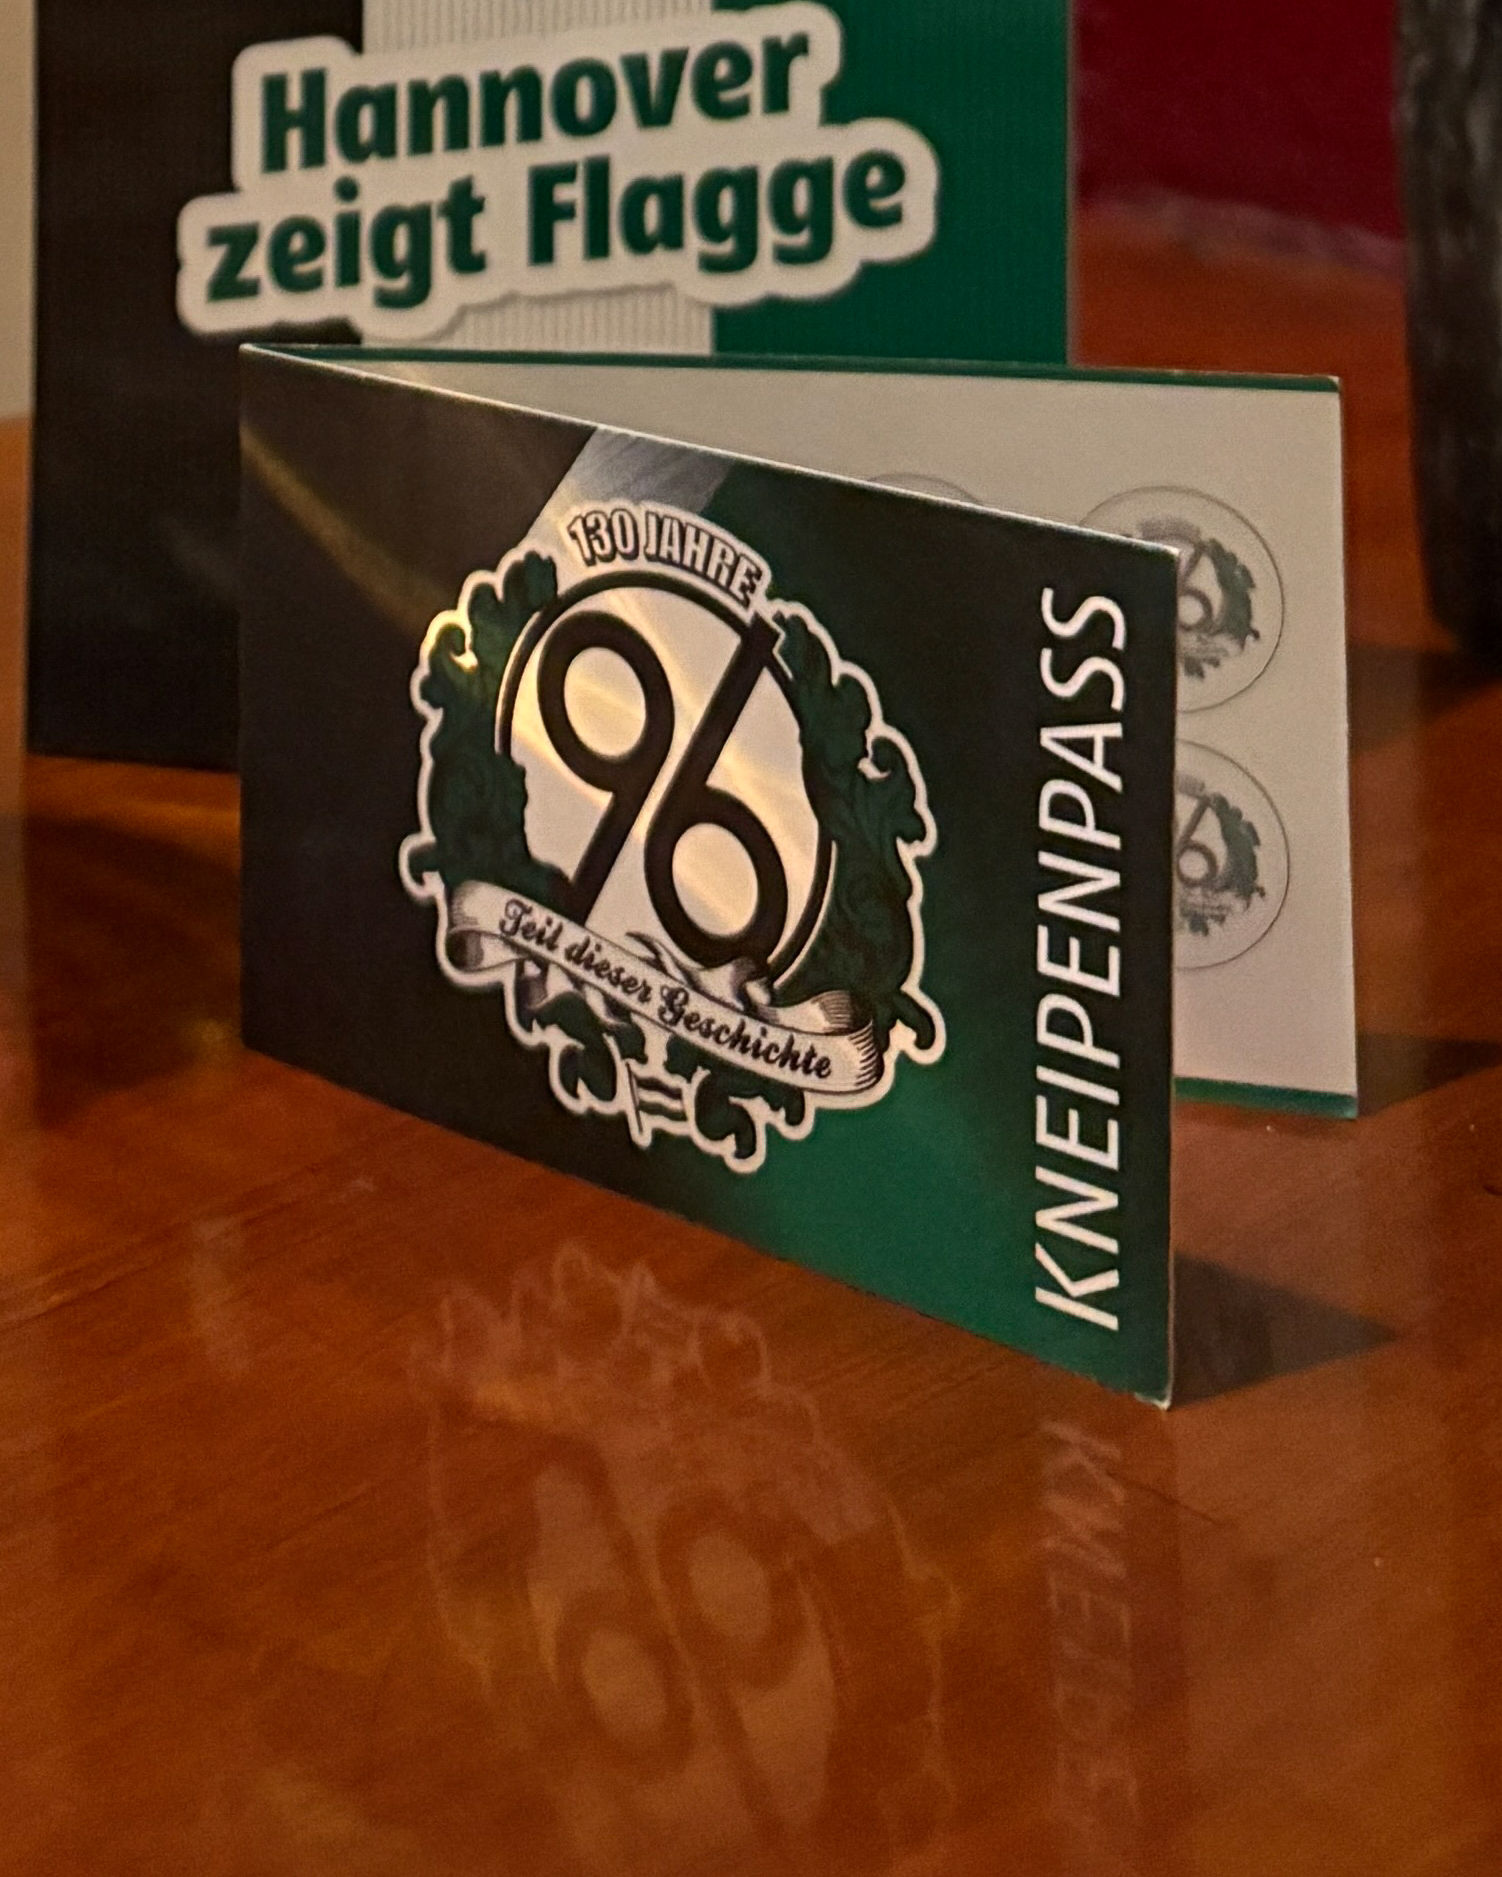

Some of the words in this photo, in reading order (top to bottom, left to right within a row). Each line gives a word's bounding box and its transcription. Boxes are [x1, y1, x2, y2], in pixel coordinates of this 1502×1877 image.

[259, 31, 812, 175] Hannover
[205, 175, 488, 310] zeigt
[526, 149, 907, 275] Flagge
[566, 506, 638, 565] 130
[642, 510, 764, 609] JAHRE
[536, 608, 790, 970] 96
[498, 897, 561, 953] Teil
[565, 929, 654, 1007] dieser
[658, 984, 833, 1082] Geschichte
[1034, 585, 1128, 1332] KNEIPENPASS
